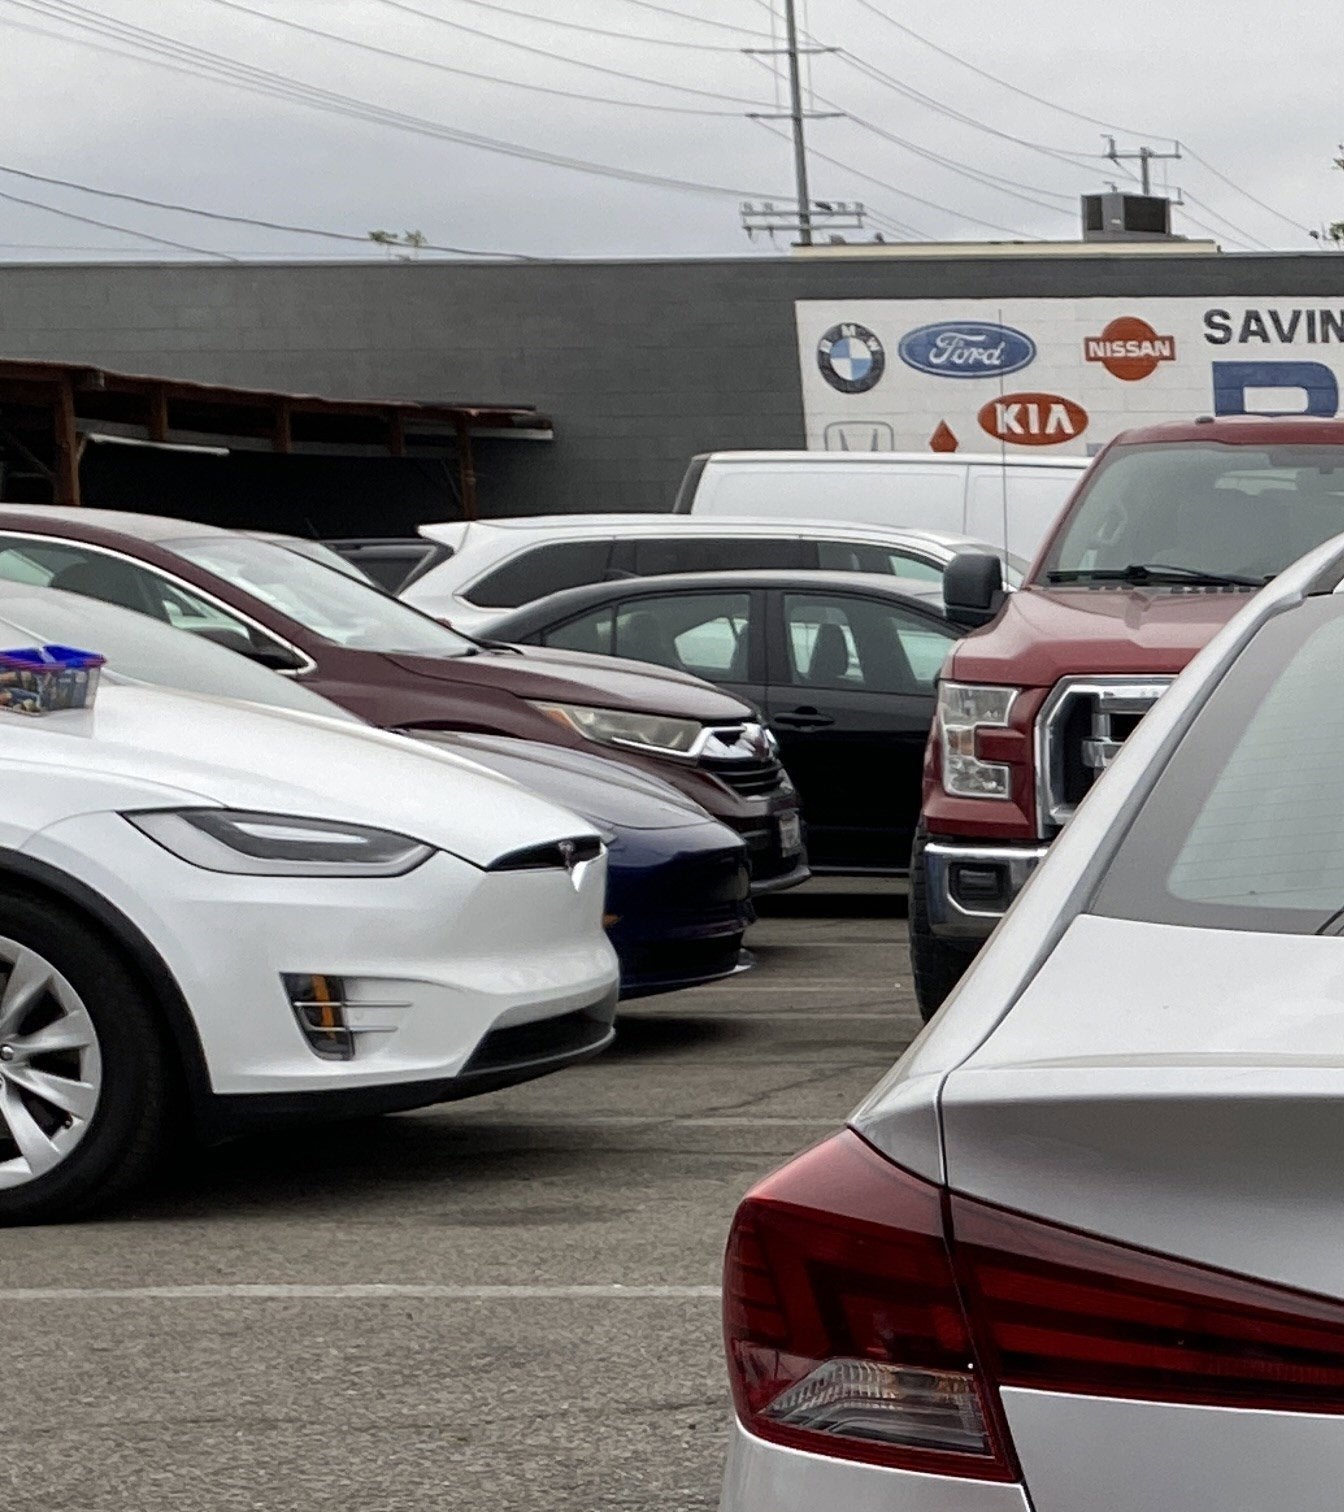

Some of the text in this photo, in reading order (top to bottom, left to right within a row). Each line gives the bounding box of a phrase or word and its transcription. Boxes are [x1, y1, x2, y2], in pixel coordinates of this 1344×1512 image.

[928, 331, 1006, 366] Ford
[1088, 340, 1171, 358] NISSAN
[995, 403, 1075, 435] KIA
